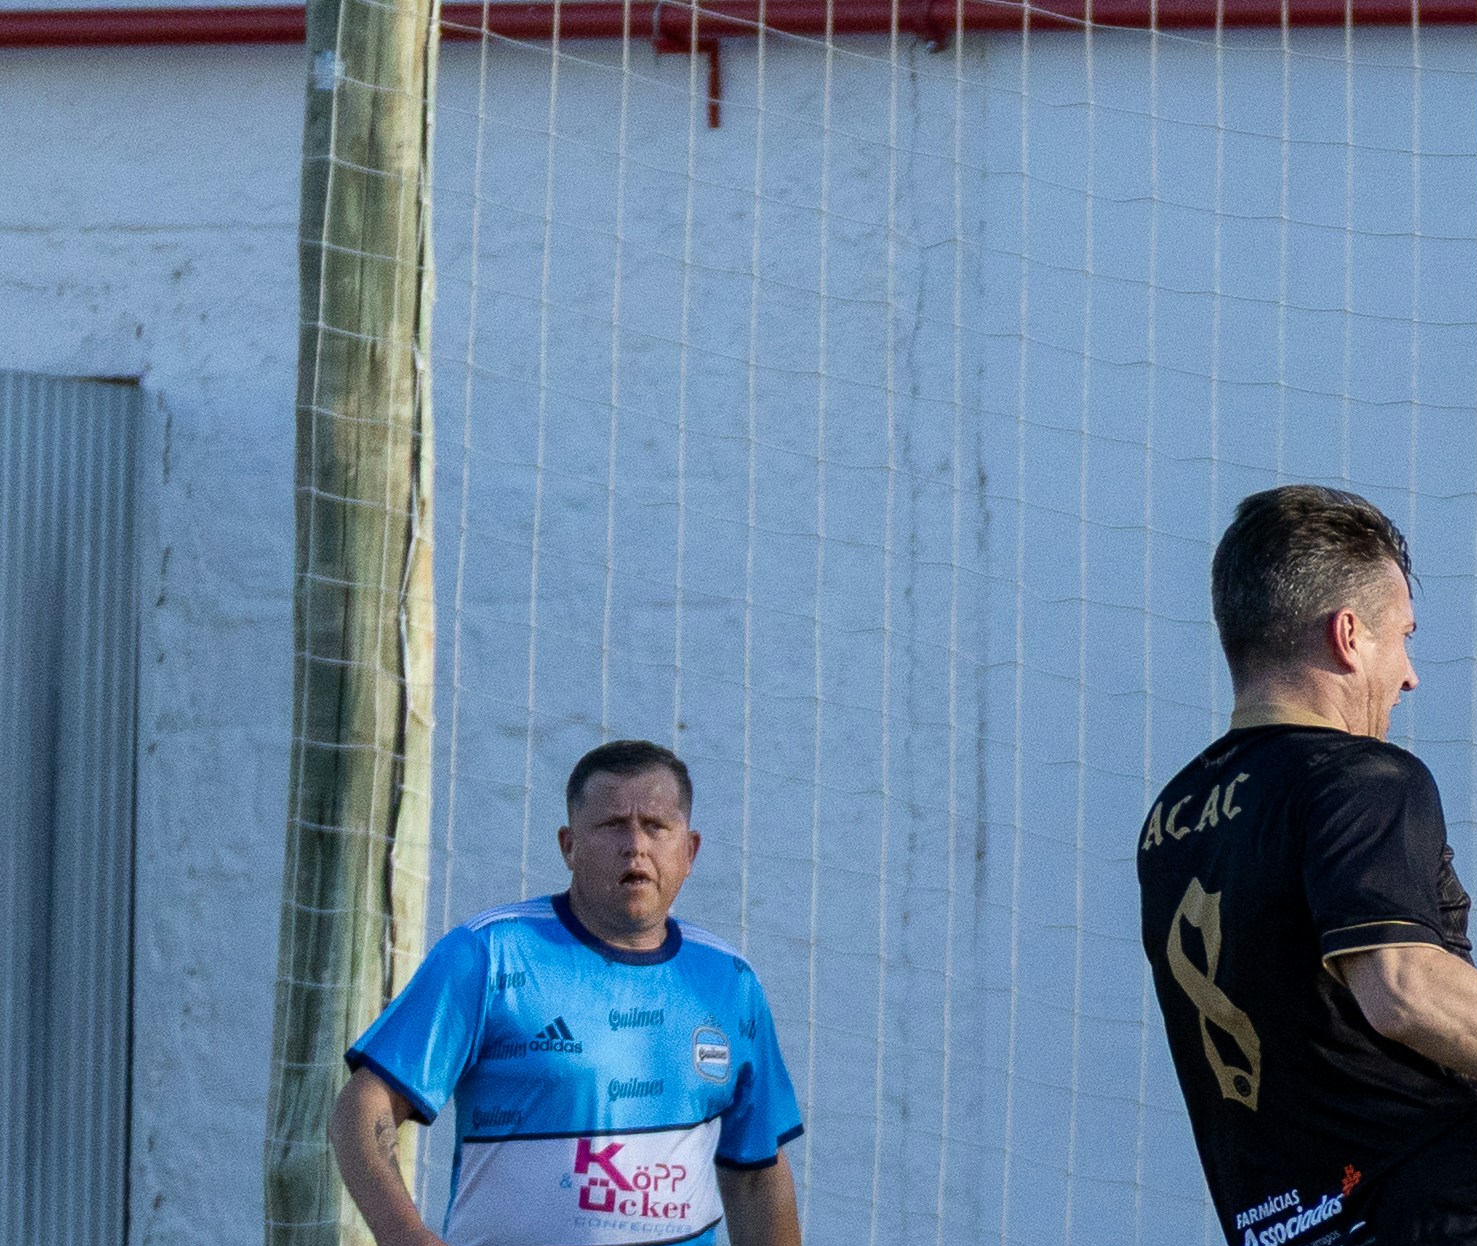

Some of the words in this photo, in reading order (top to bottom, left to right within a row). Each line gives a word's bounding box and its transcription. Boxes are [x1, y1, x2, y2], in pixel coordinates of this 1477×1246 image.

[1143, 772, 1250, 851] ACAC
[1166, 876, 1261, 1112] 8
[608, 1007, 665, 1032] Quilmes
[529, 1037, 583, 1055] adidas
[608, 1077, 665, 1102] Quilmes
[578, 1177, 691, 1220] Ücker
[1236, 1189, 1301, 1230] FARMÁCIAS
